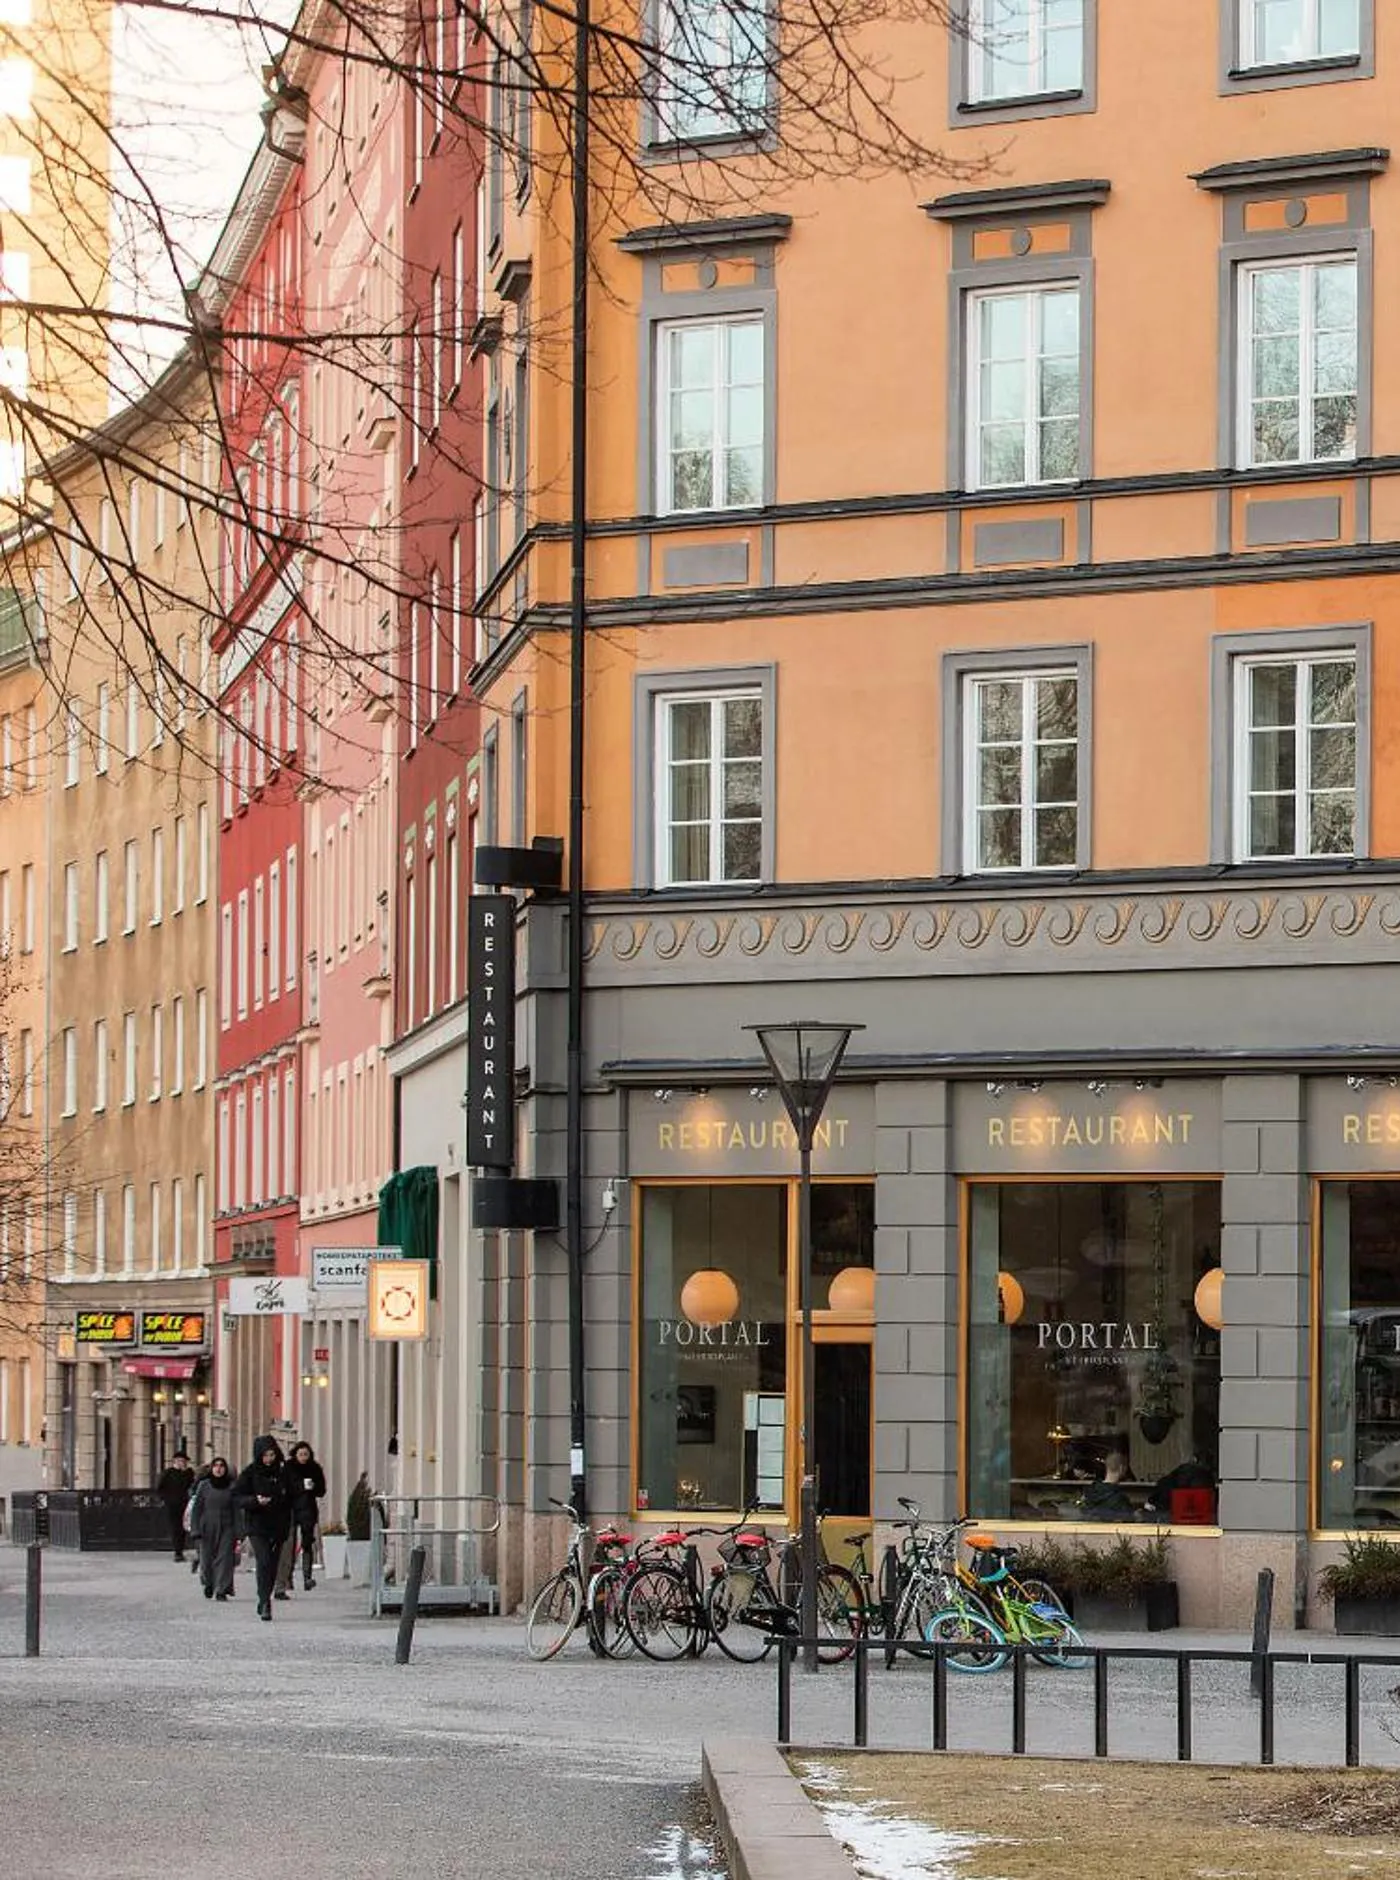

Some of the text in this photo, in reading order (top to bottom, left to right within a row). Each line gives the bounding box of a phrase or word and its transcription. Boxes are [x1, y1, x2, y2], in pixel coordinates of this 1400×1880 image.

[483, 912, 495, 1149] RESTAURANT
[659, 1119, 848, 1149] RESTAURNT
[988, 1113, 1193, 1145] RESTAURANT
[659, 1321, 770, 1345] PORTAL
[1037, 1323, 1158, 1348] PORTAL
